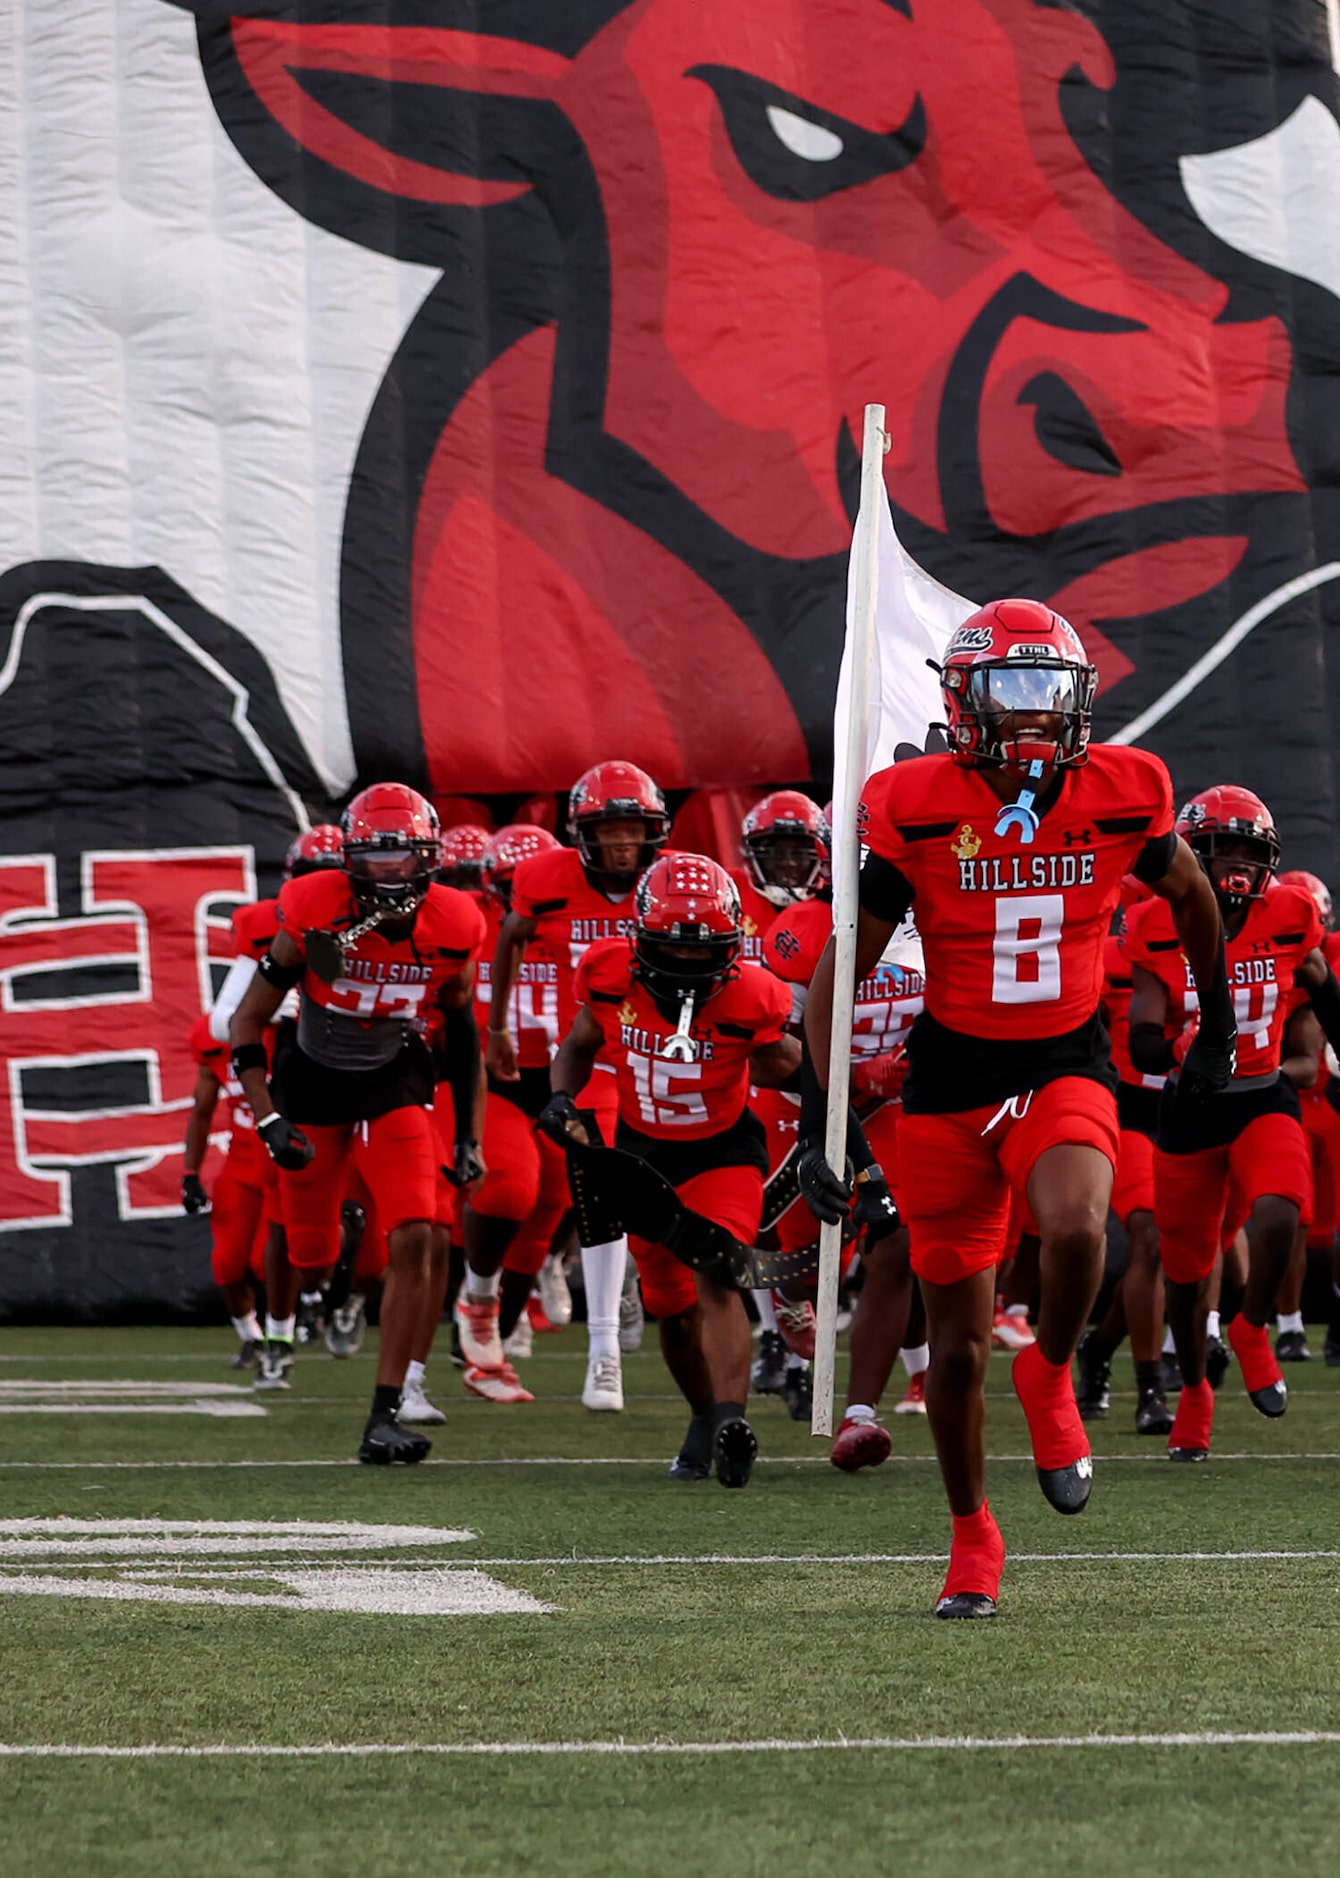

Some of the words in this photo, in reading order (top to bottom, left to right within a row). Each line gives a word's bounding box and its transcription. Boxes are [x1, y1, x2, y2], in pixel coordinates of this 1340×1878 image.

[958, 853, 1096, 891] HILLSIDE
[570, 918, 634, 941] HILLS
[991, 894, 1064, 1004] 8
[479, 961, 558, 983] HSIDE
[626, 1051, 710, 1125] 15
